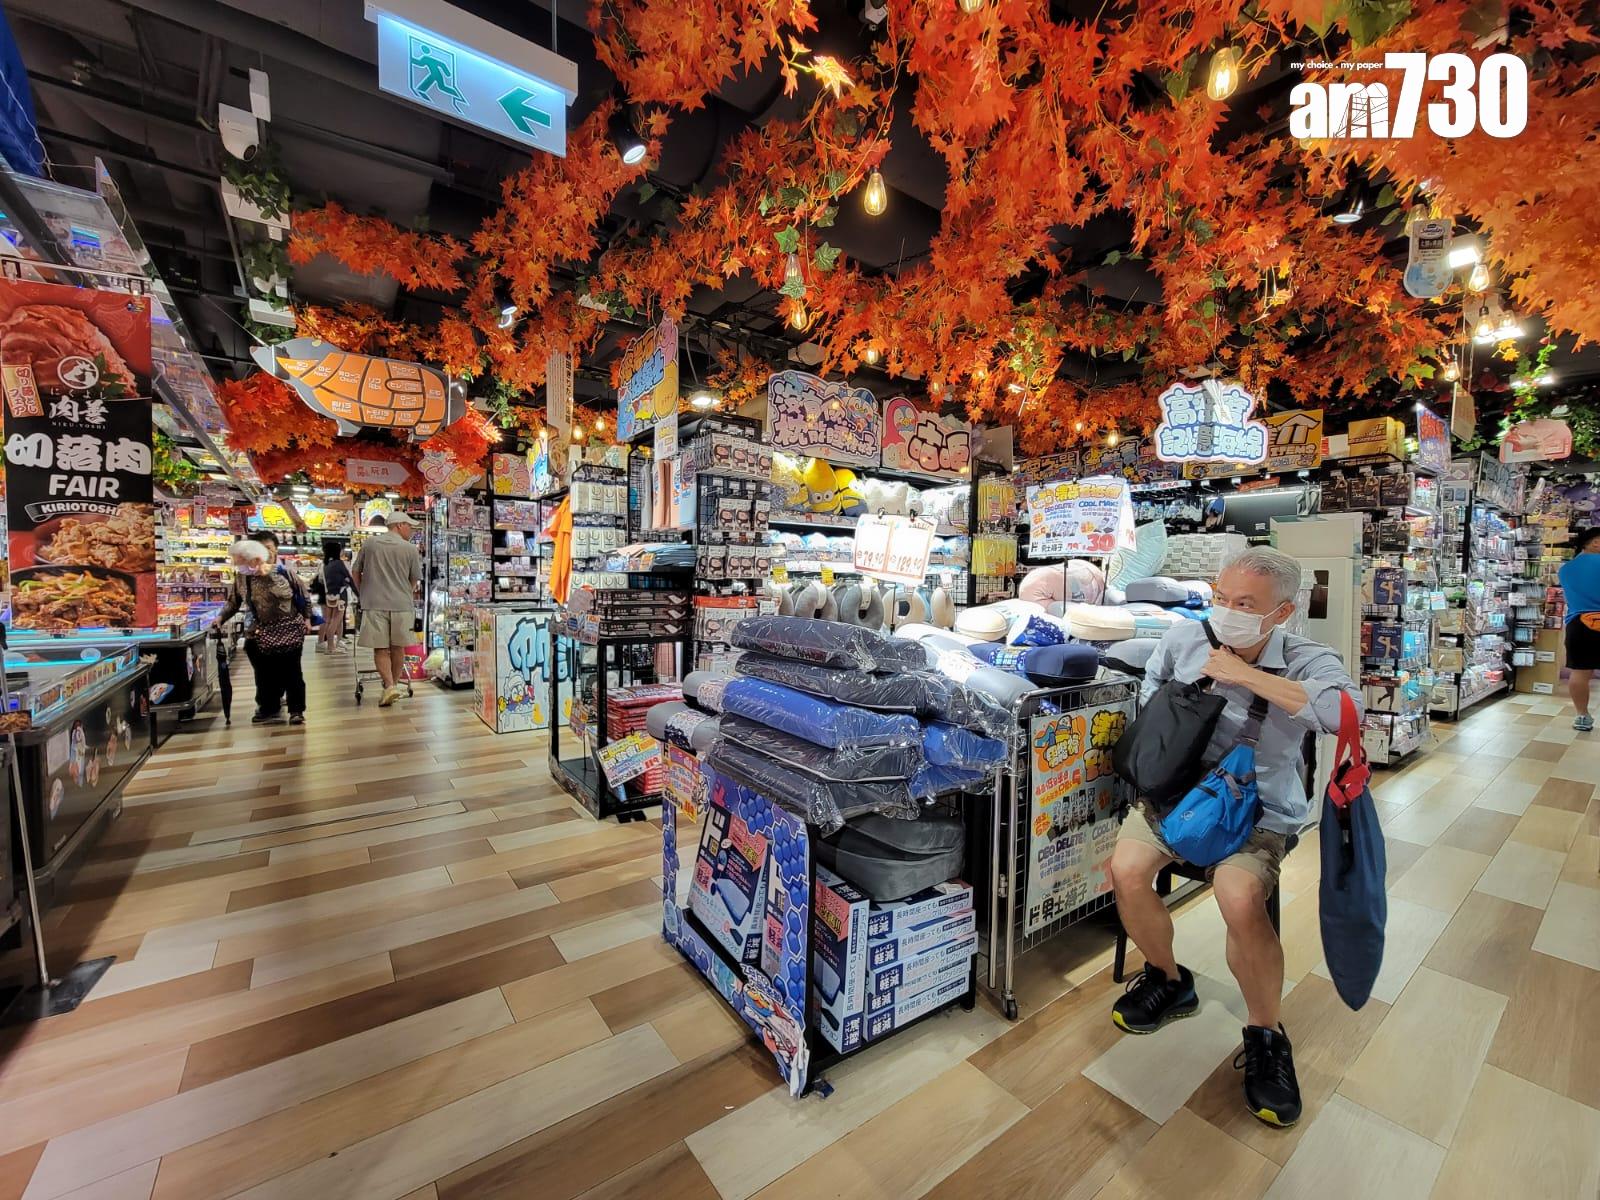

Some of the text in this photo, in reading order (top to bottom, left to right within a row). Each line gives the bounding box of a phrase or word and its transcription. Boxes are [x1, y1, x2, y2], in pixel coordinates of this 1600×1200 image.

[51, 388, 107, 400] にくよし
[1161, 426, 1263, 460] 記憶海綿
[1270, 445, 1315, 457] ITEMS
[49, 474, 120, 499] FAIR
[1078, 500, 1097, 508] COOL
[1086, 533, 1115, 552] 30
[1042, 883, 1088, 921] 男士襪子
